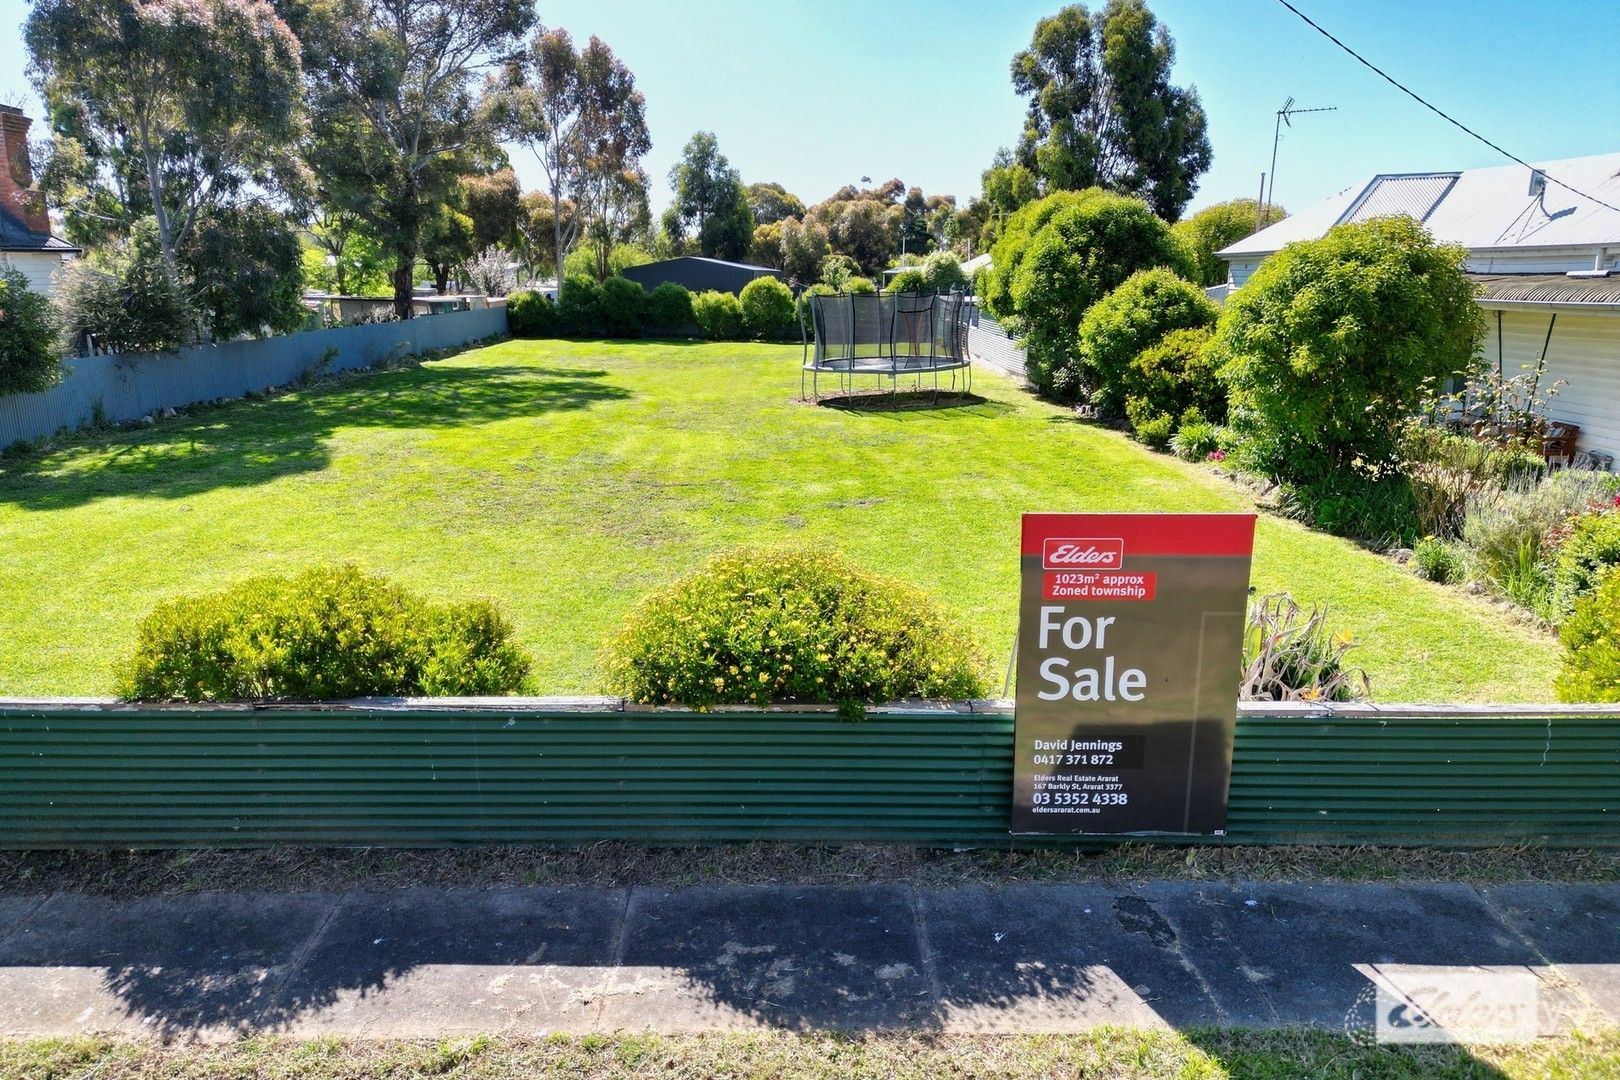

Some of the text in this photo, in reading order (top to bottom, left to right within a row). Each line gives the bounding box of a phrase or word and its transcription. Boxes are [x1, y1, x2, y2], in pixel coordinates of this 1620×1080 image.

[1050, 544, 1117, 564] Elders
[1103, 575, 1144, 586] approx
[1052, 584, 1146, 598] Zoned township
[1039, 605, 1116, 650] For
[1037, 655, 1147, 701] Sale
[1034, 740, 1123, 752] David Jennings
[1033, 755, 1114, 765] 0417 371 872
[1048, 783, 1071, 791] Barkly
[1105, 783, 1123, 791] 3377
[1032, 792, 1128, 805] 03 5352 4338
[1032, 806, 1101, 814] eldersararat.com.au
